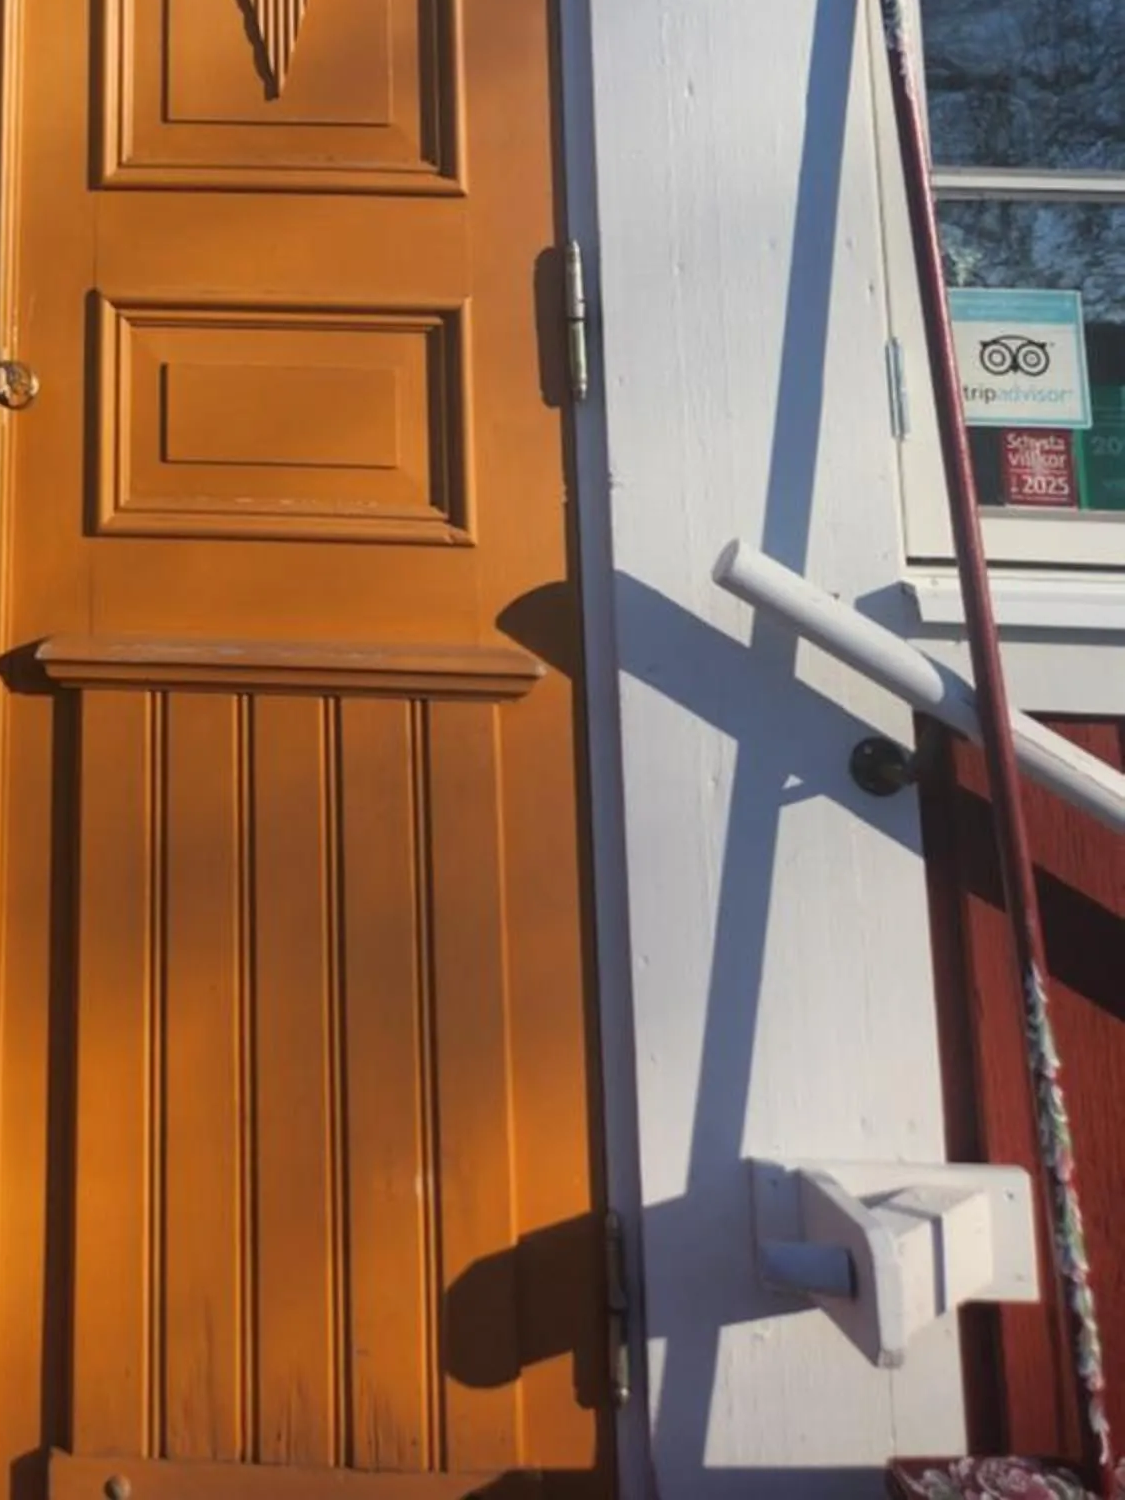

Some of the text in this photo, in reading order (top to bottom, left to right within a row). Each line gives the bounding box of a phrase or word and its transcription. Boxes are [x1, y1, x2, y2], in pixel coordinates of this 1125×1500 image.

[963, 382, 1067, 405] tripadvisor
[1090, 435, 1125, 457] 20
[1022, 475, 1069, 494] 2025
